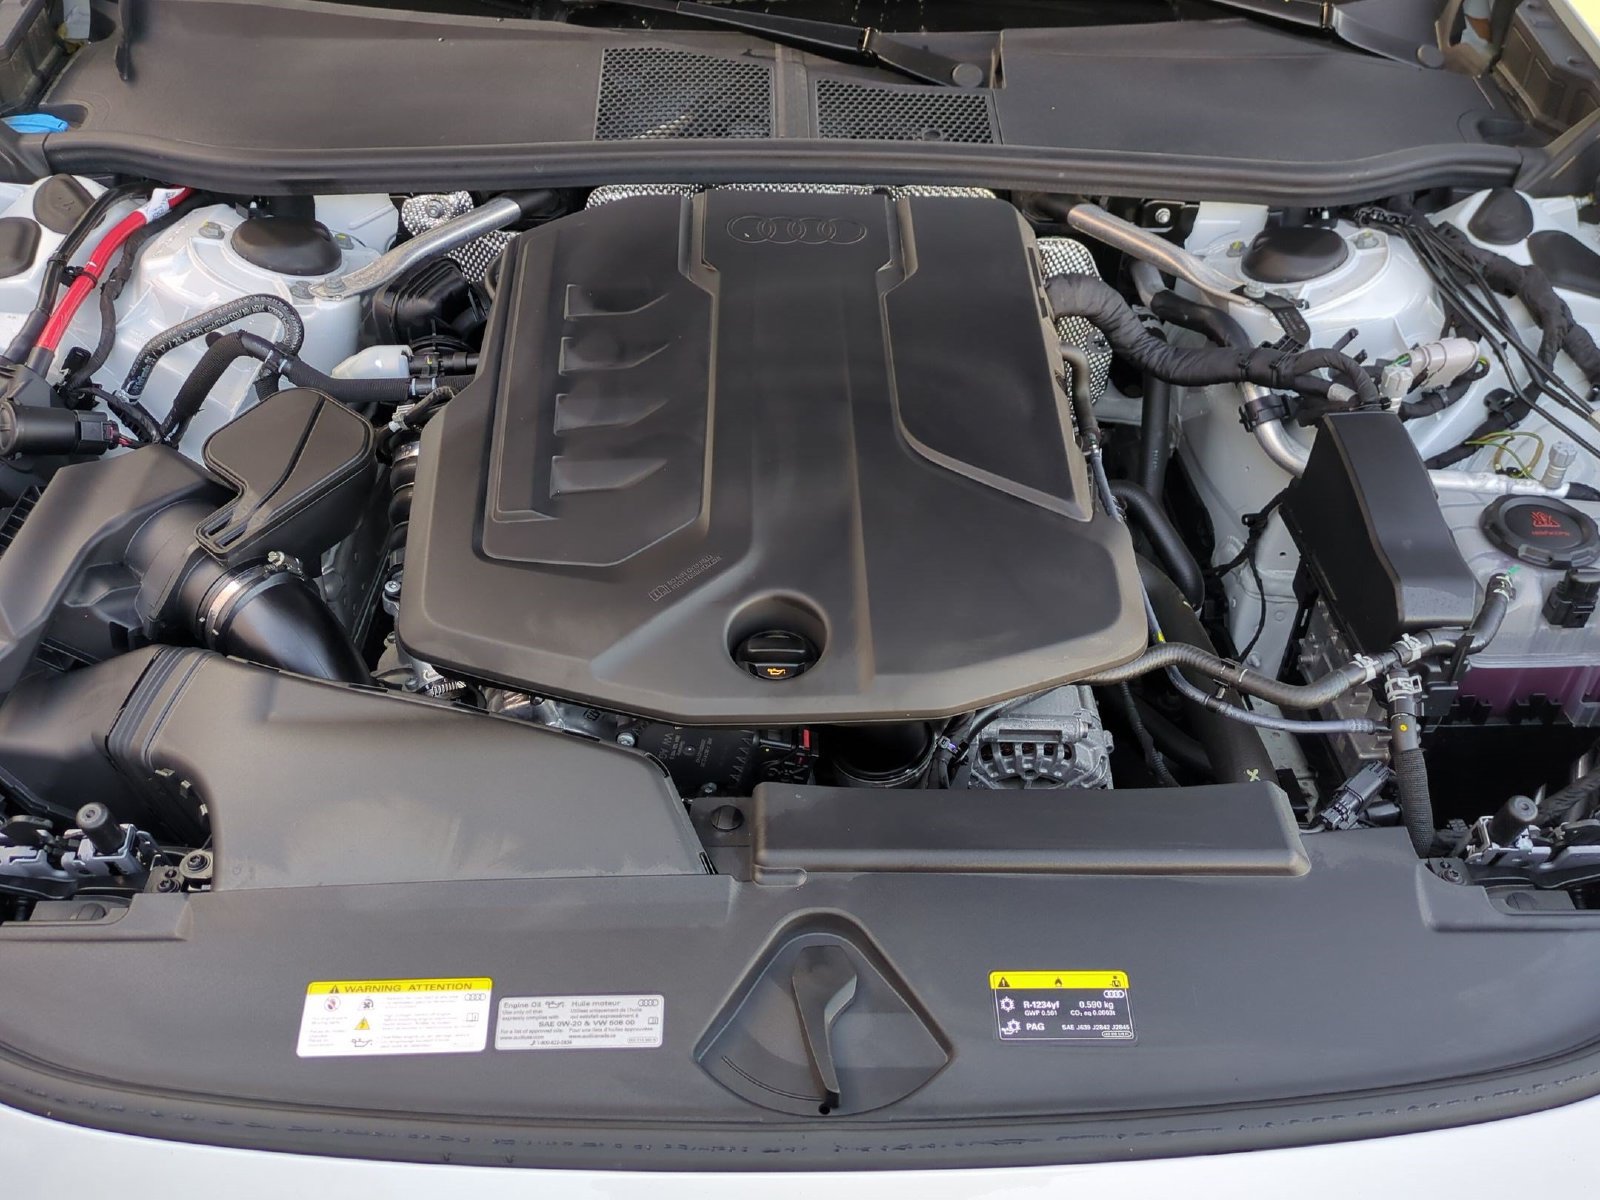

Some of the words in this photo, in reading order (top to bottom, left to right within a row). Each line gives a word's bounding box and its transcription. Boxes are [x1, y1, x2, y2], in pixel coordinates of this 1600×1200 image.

[344, 985, 401, 993] WARNING
[408, 983, 473, 991] ATTENTION
[1023, 1001, 1060, 1009] R-1234yf
[1104, 1001, 1114, 1010] kg
